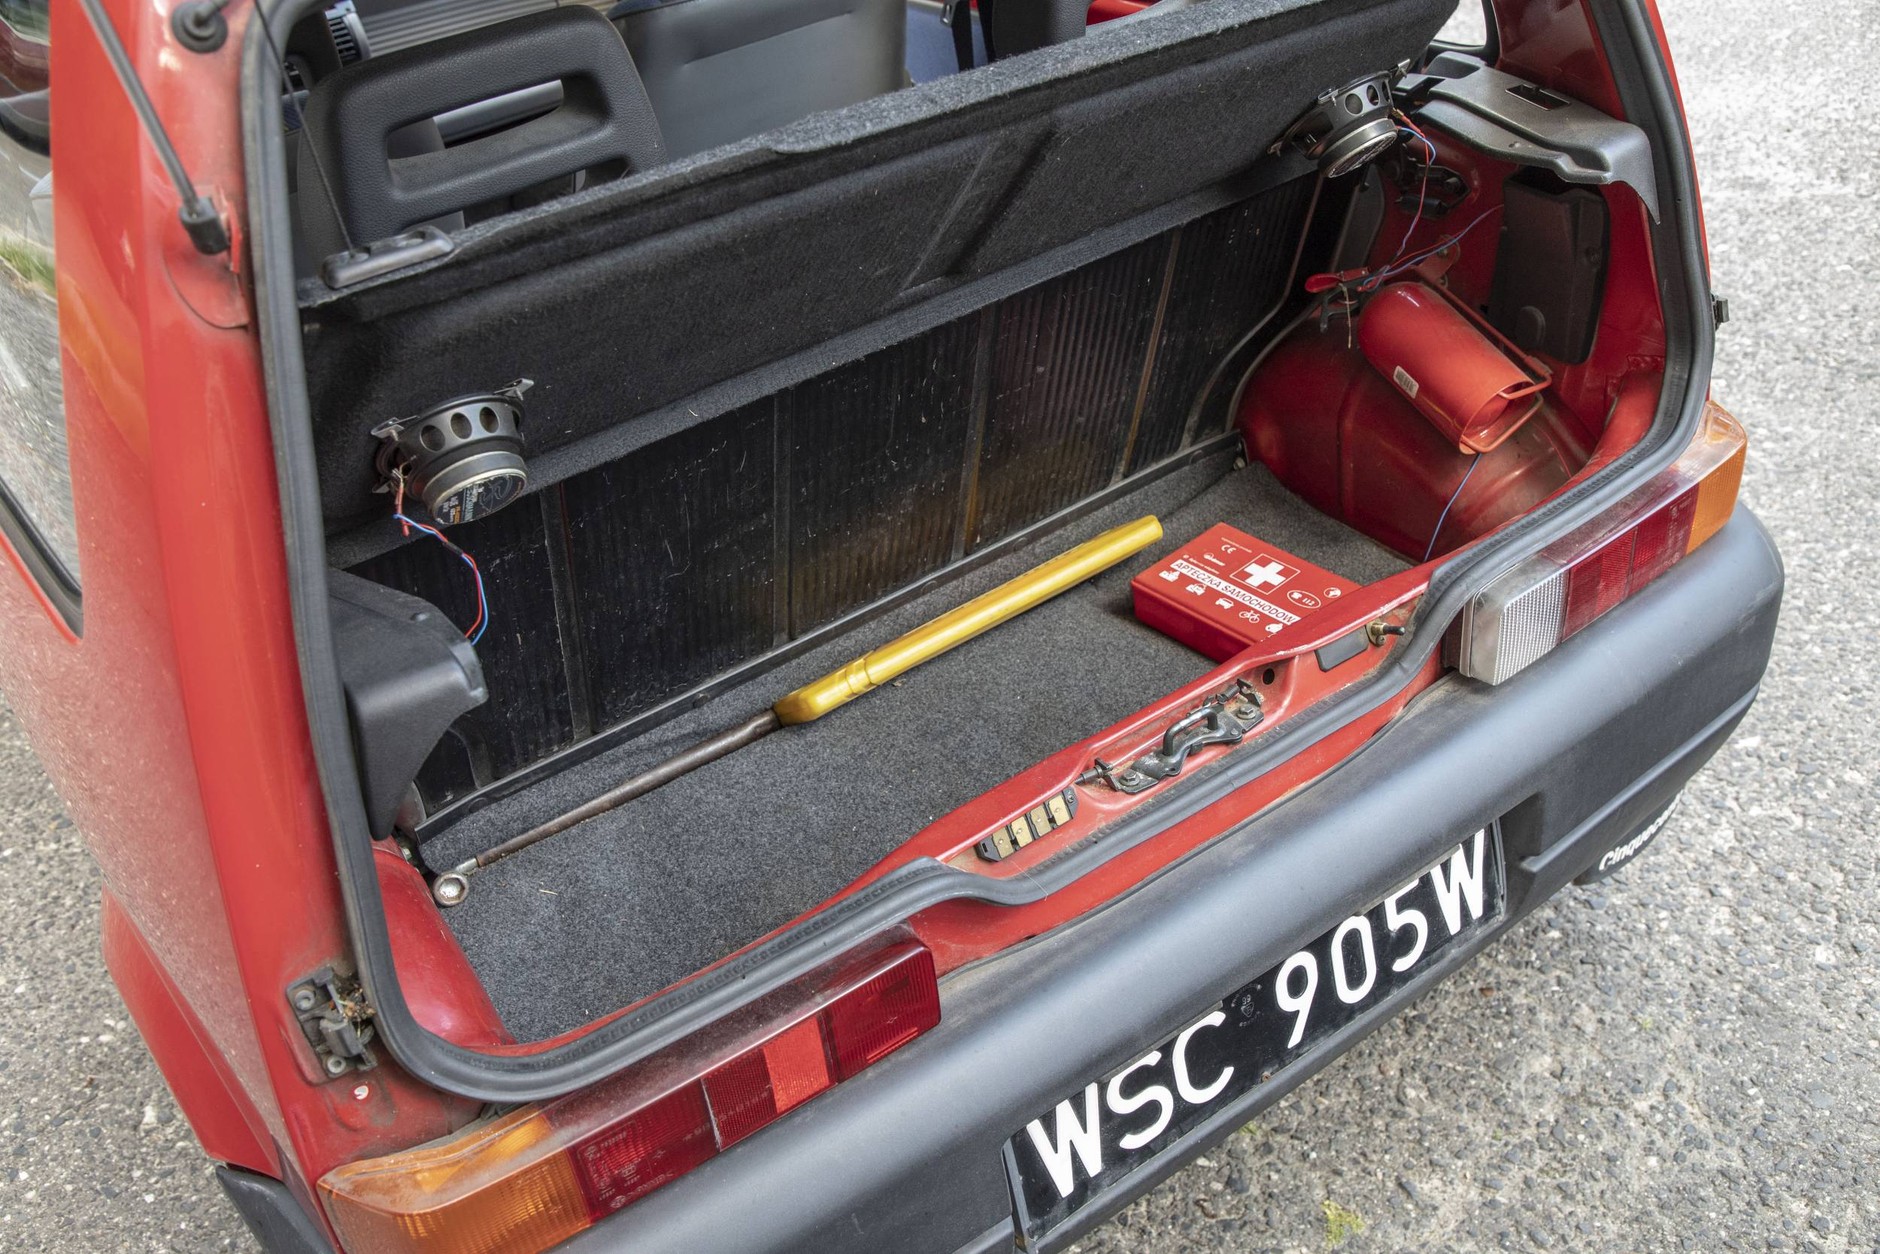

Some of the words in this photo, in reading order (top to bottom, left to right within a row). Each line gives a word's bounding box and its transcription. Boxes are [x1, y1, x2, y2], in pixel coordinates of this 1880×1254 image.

[1173, 561, 1221, 588] APTECZKA
[1302, 598, 1316, 607] 112
[1599, 789, 1685, 871] Cinquece
[1027, 1010, 1235, 1200] WSC
[1274, 828, 1486, 1048] 905W
